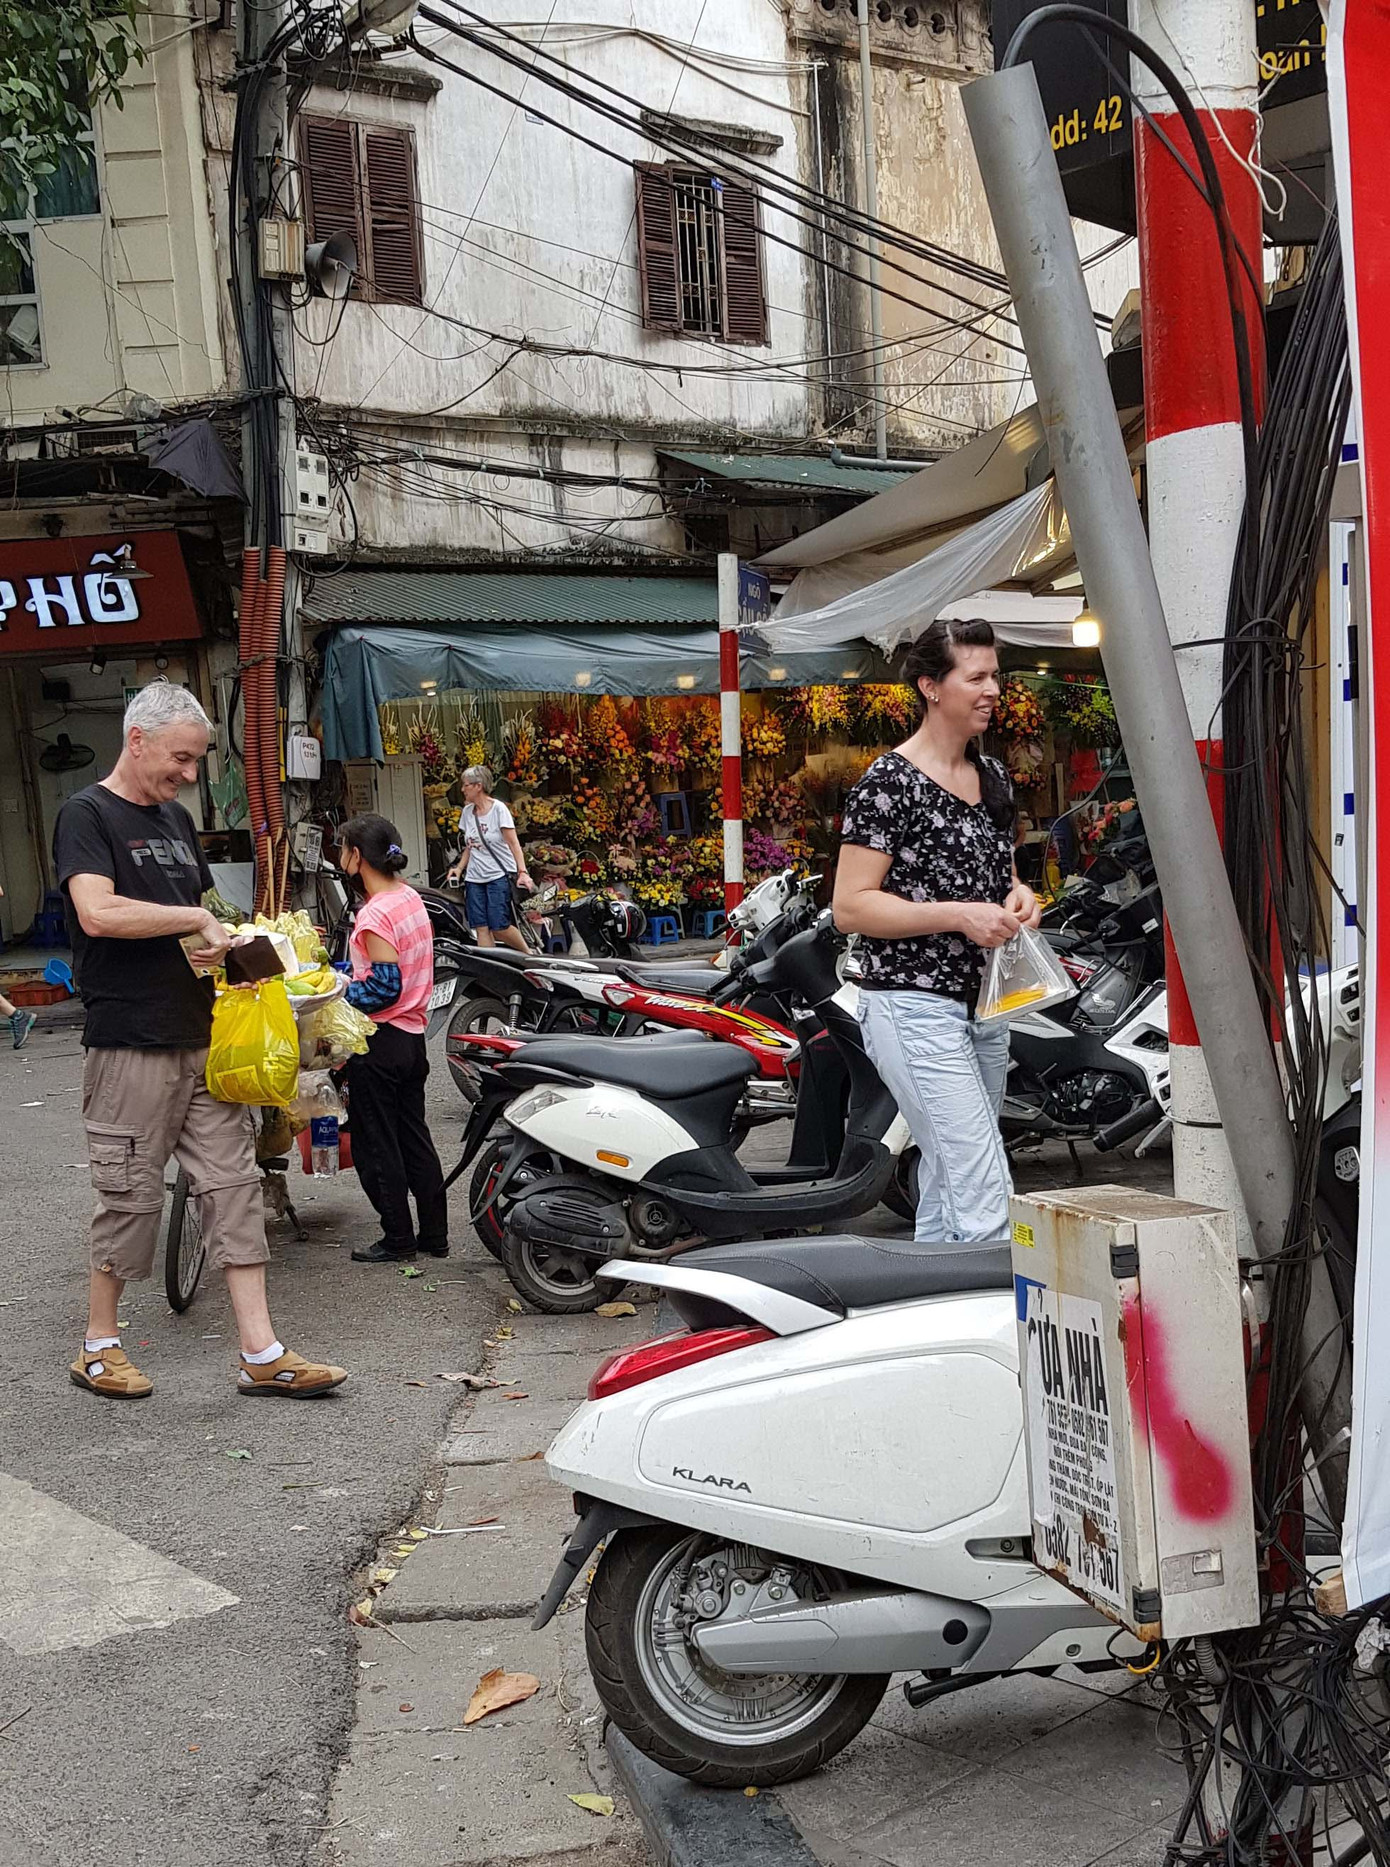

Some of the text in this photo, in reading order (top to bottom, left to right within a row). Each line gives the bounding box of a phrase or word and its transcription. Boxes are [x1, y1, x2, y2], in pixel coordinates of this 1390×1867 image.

[1094, 95, 1123, 134] 42
[1028, 1287, 1109, 1417] ỬA NHÀ
[672, 1466, 752, 1494] KLARA
